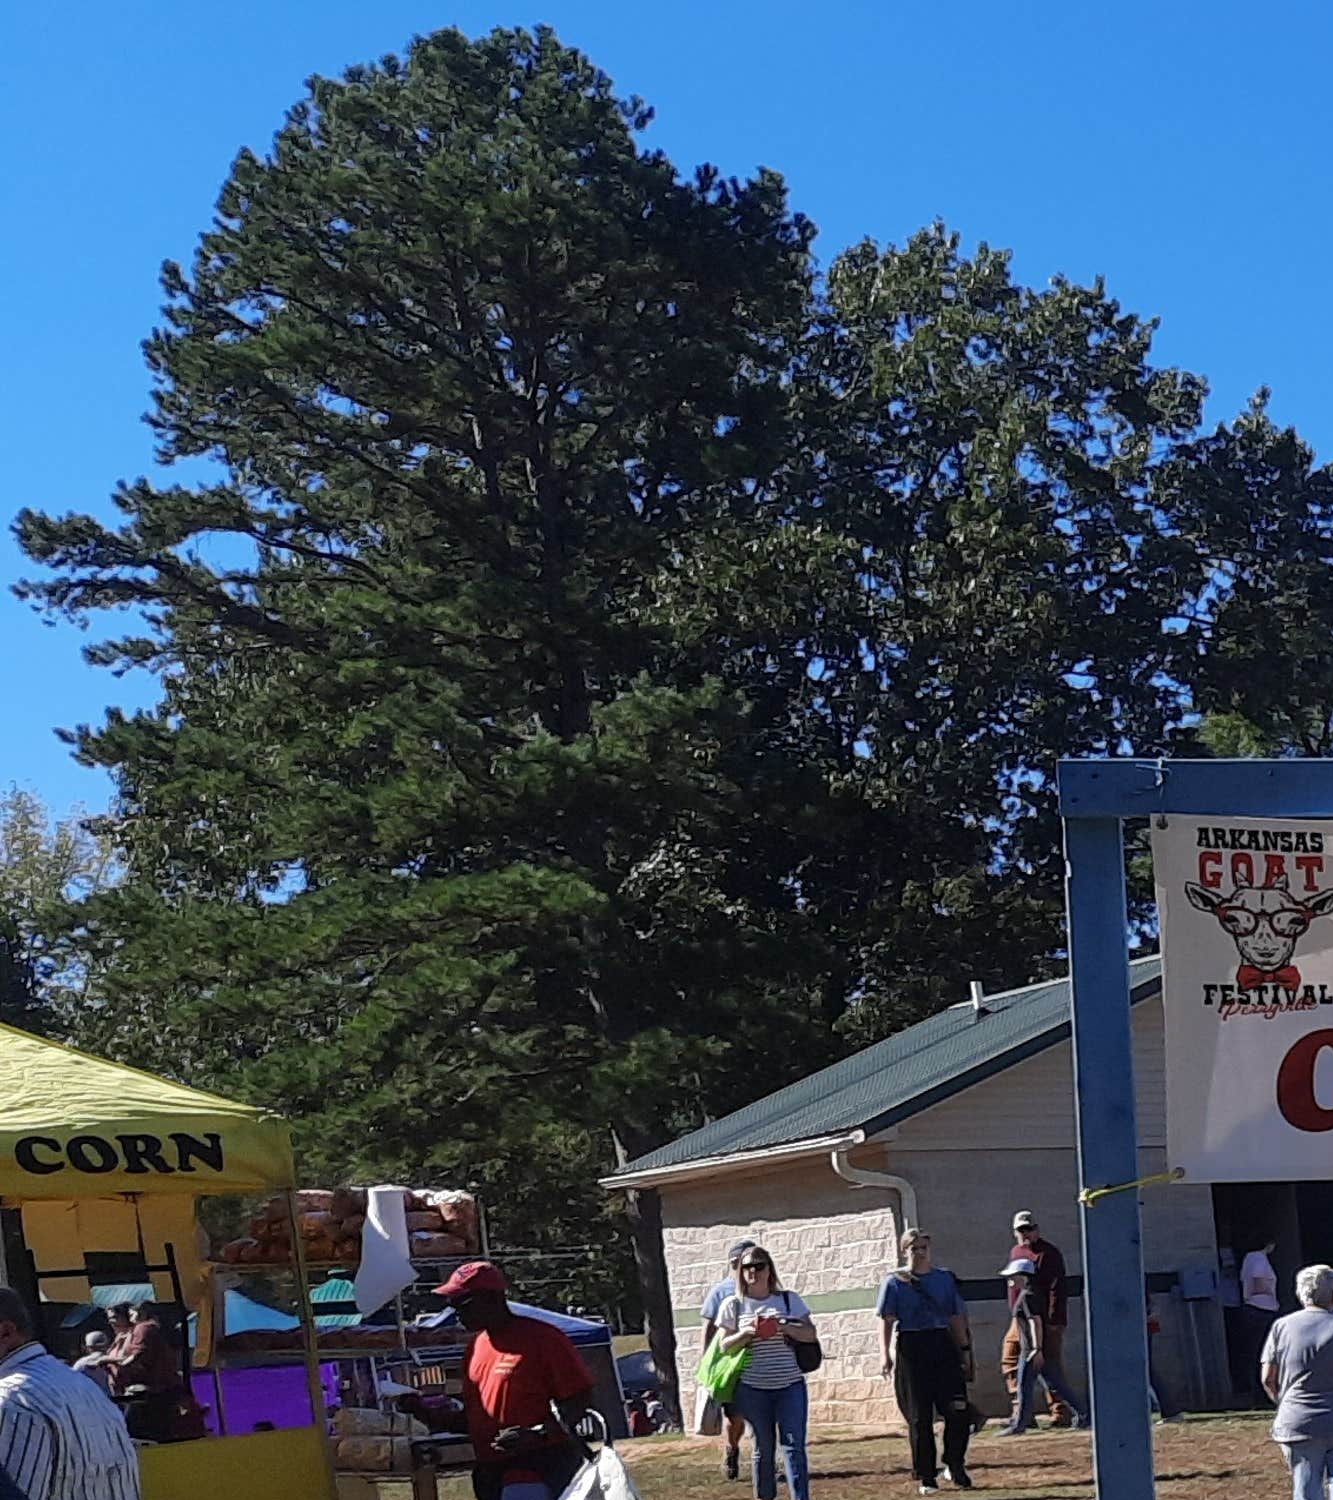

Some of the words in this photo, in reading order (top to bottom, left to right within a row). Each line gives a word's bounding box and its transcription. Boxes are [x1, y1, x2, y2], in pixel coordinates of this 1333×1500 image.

[1197, 827, 1324, 853] ARKANSAS
[1199, 851, 1324, 892] GOAT
[1203, 983, 1333, 1006] FESTIVAL
[14, 1132, 223, 1175] CORN
